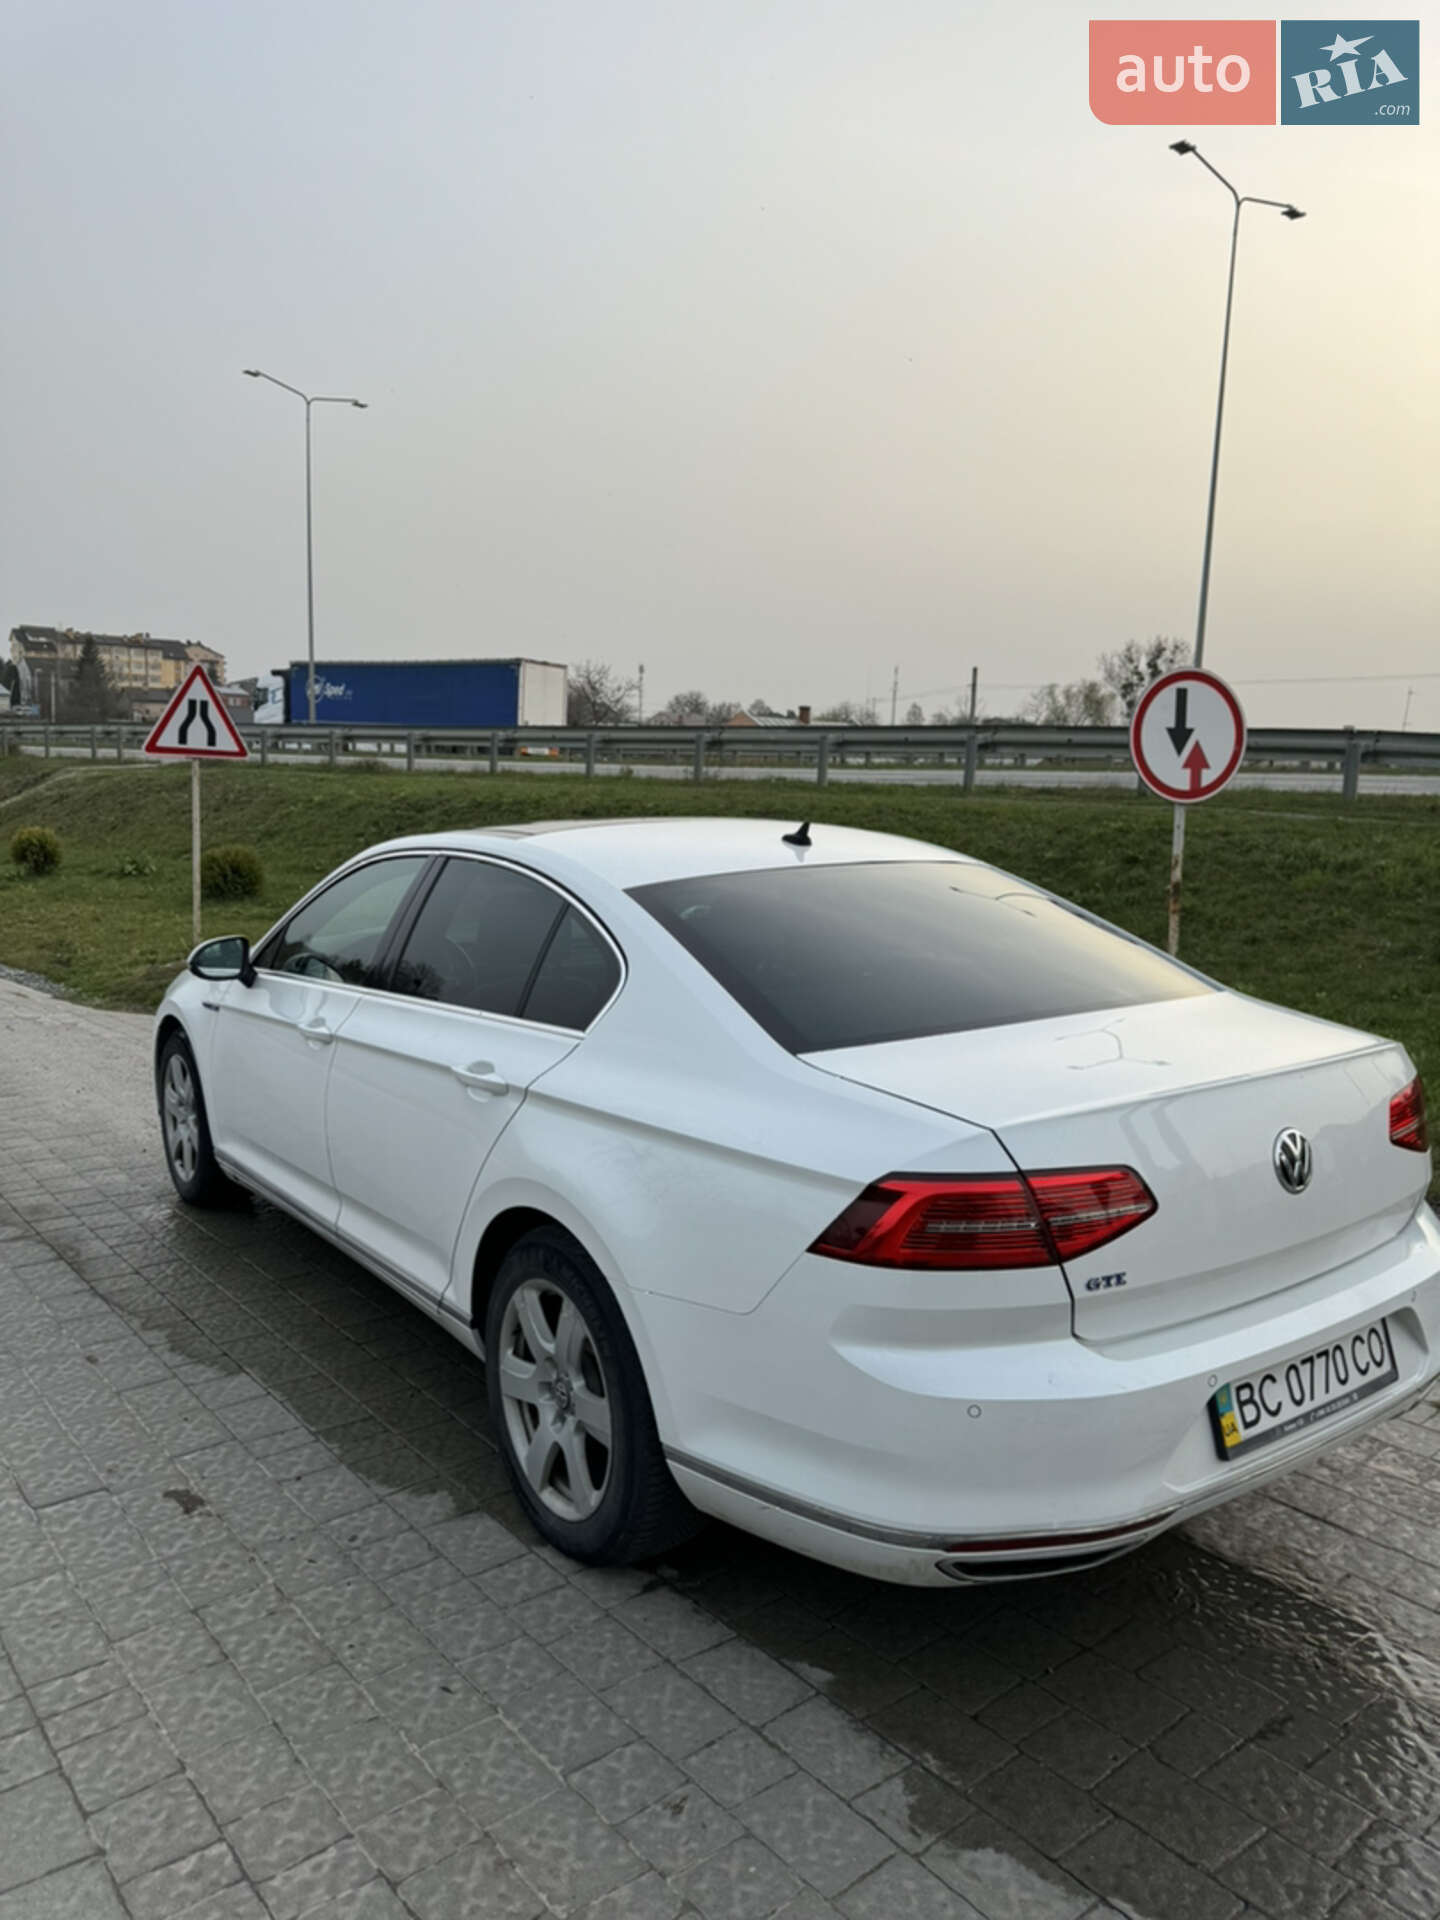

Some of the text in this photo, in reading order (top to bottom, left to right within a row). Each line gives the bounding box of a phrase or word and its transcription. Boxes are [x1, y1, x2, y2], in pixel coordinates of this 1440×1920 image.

[1086, 1272, 1127, 1291] GTE
[1236, 1373, 1282, 1430] BC
[1285, 1344, 1349, 1407] 0770
[1351, 1327, 1385, 1376] CO
